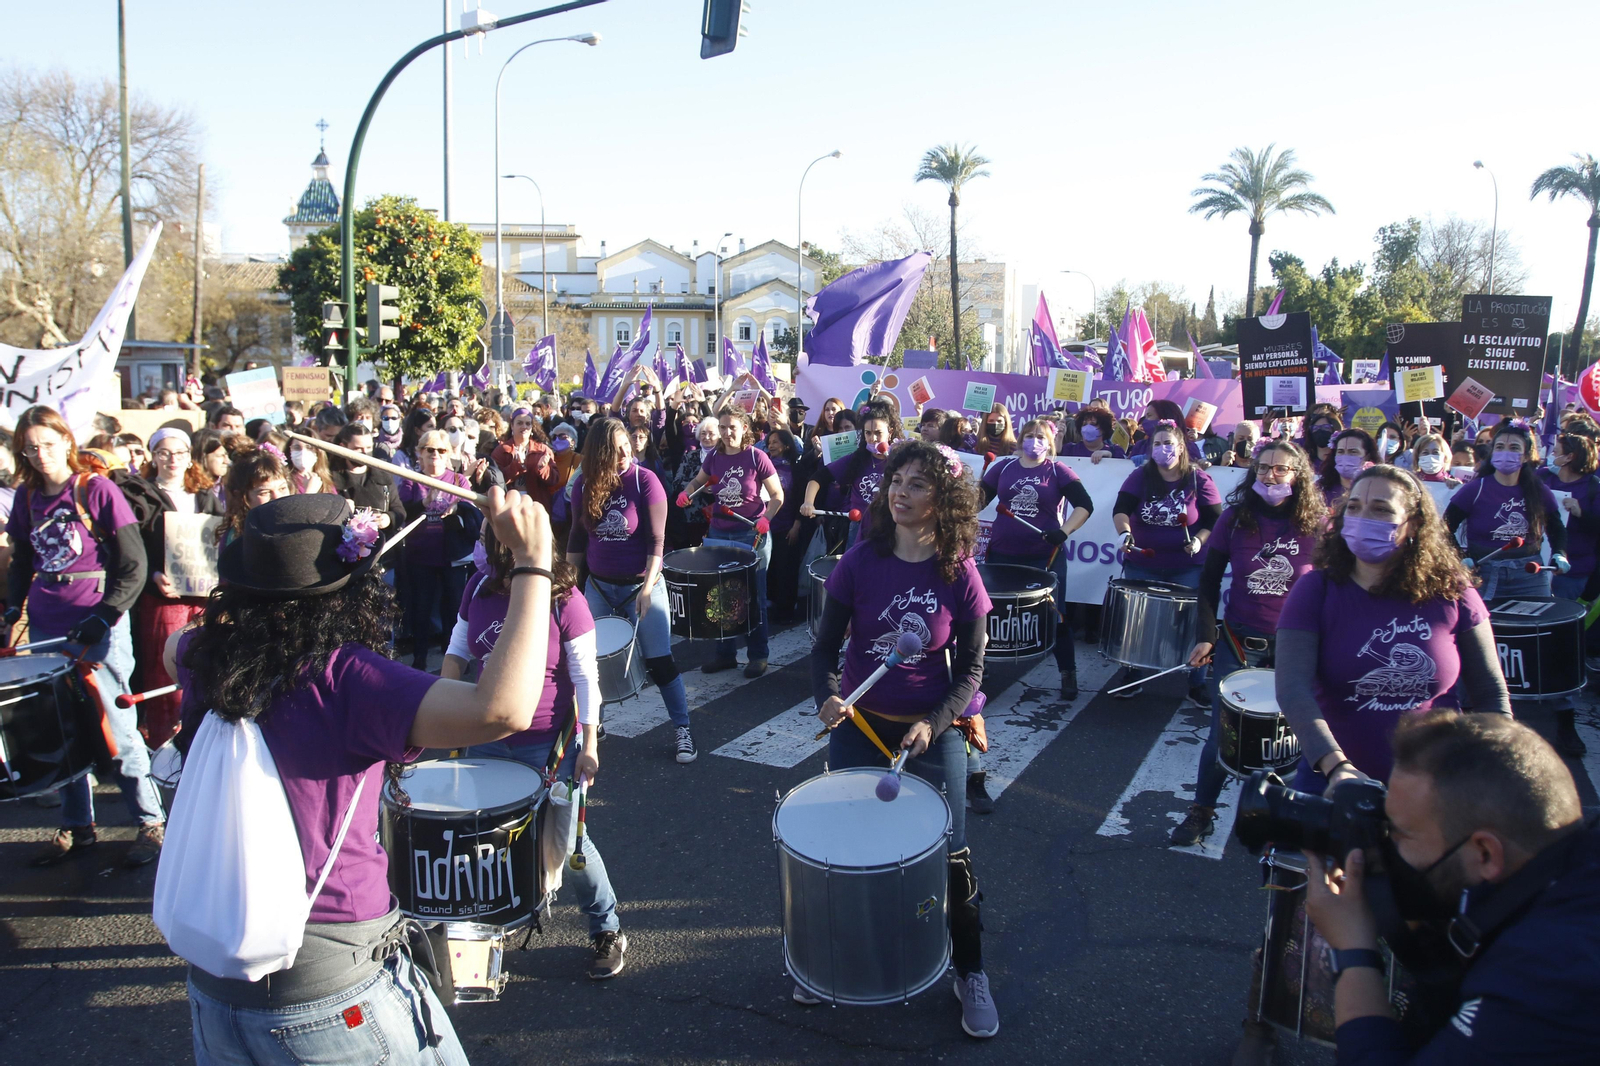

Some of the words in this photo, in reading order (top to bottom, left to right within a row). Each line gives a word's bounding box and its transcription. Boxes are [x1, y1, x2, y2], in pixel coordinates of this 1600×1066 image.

[1468, 300, 1483, 314] LA
[1481, 318, 1499, 328] ES
[1463, 334, 1476, 345] LA
[1478, 335, 1542, 348] ESCLAVITUD
[1263, 341, 1303, 353] MUJERES
[1252, 353, 1265, 361] HAY
[1266, 350, 1299, 360] PERSONAS
[1485, 348, 1515, 358] SIGUE
[1244, 361, 1267, 370] SIENDO
[1268, 357, 1308, 368] EXPLOTADAS
[1395, 356, 1403, 364] YO
[1404, 356, 1431, 364] CAMINO
[1467, 359, 1530, 372] EXISTIENDO.
[1244, 370, 1253, 378] EN
[1254, 368, 1283, 378] NUESTRA
[1396, 365, 1409, 373] POR
[286, 372, 326, 380] FEMINISMO
[1005, 392, 1028, 412] NO
[418, 903, 453, 915] sound
[458, 903, 494, 915] sister
